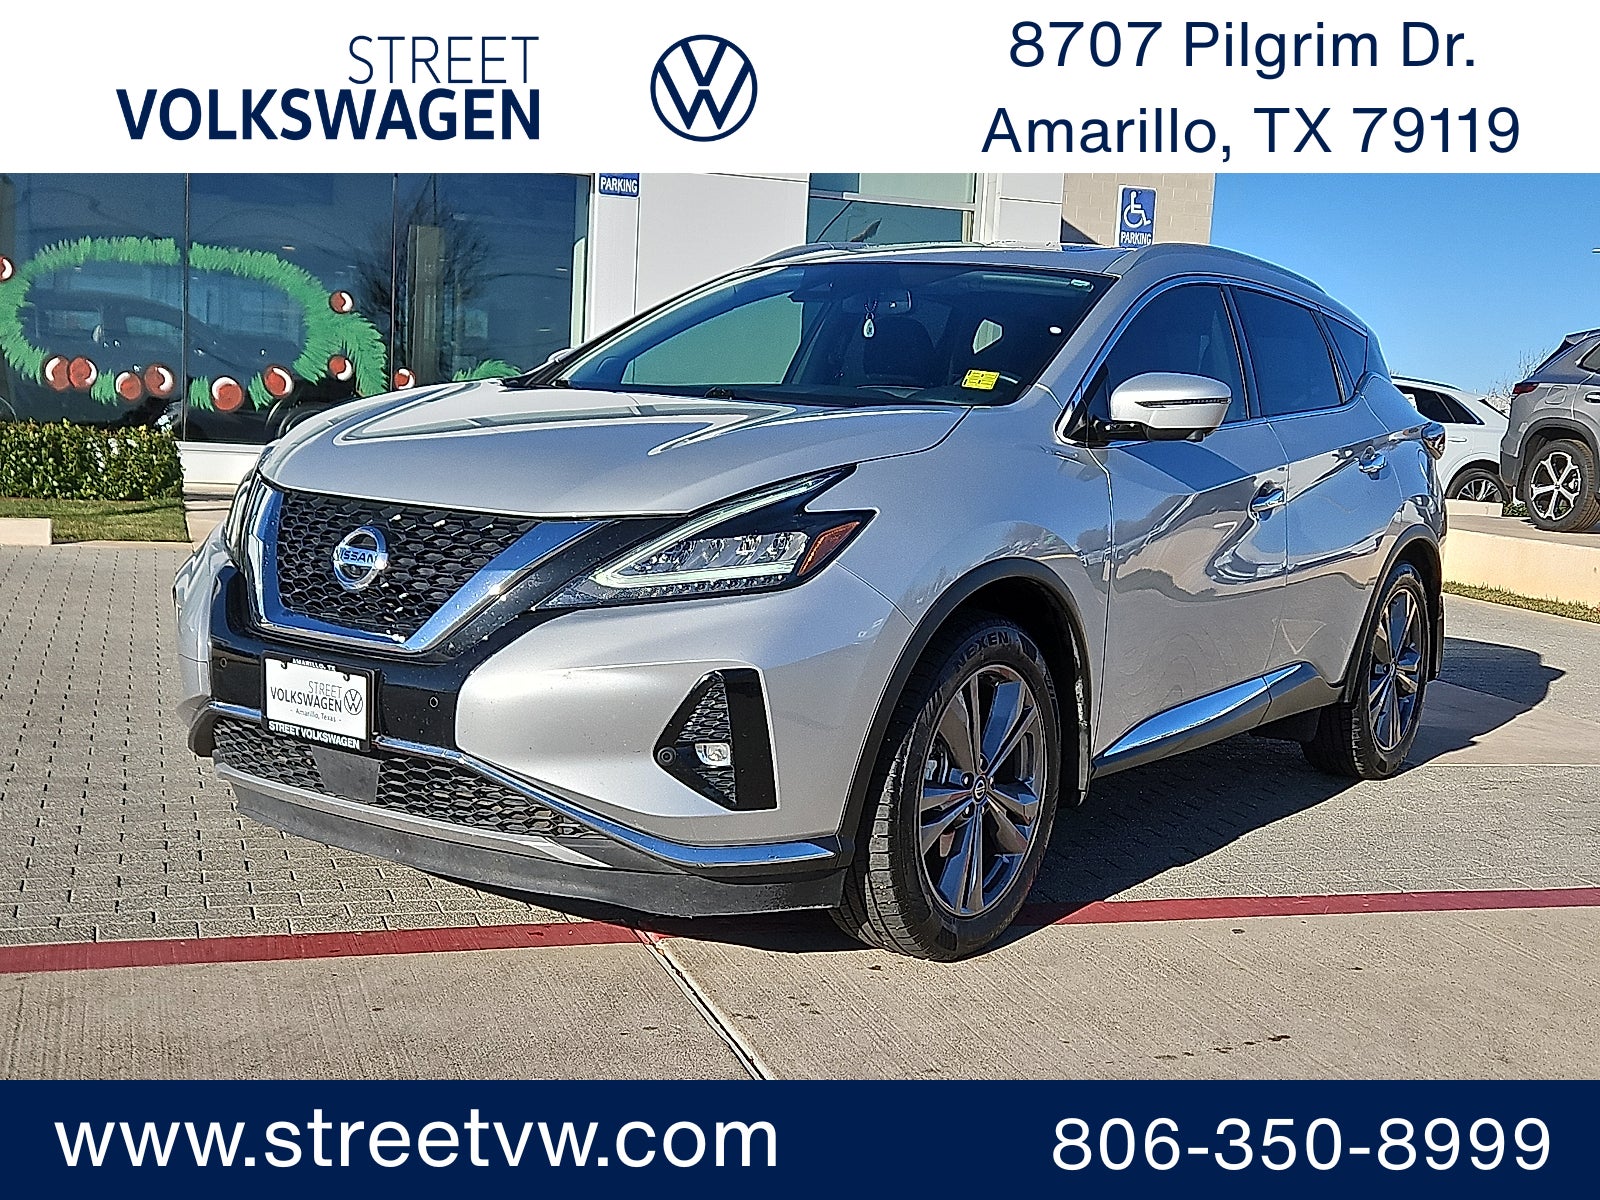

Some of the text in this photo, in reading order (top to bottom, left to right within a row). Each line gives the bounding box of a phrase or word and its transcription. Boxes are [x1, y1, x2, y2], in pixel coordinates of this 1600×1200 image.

[600, 176, 638, 193] PARKING
[1120, 231, 1152, 246] PARKING
[956, 631, 1011, 669] NEXEN
[308, 680, 343, 699] STREET
[270, 686, 342, 713] VOLKSWAGEN
[321, 713, 337, 723] Texas
[268, 720, 360, 750] STREET VOLKSWAGEN
